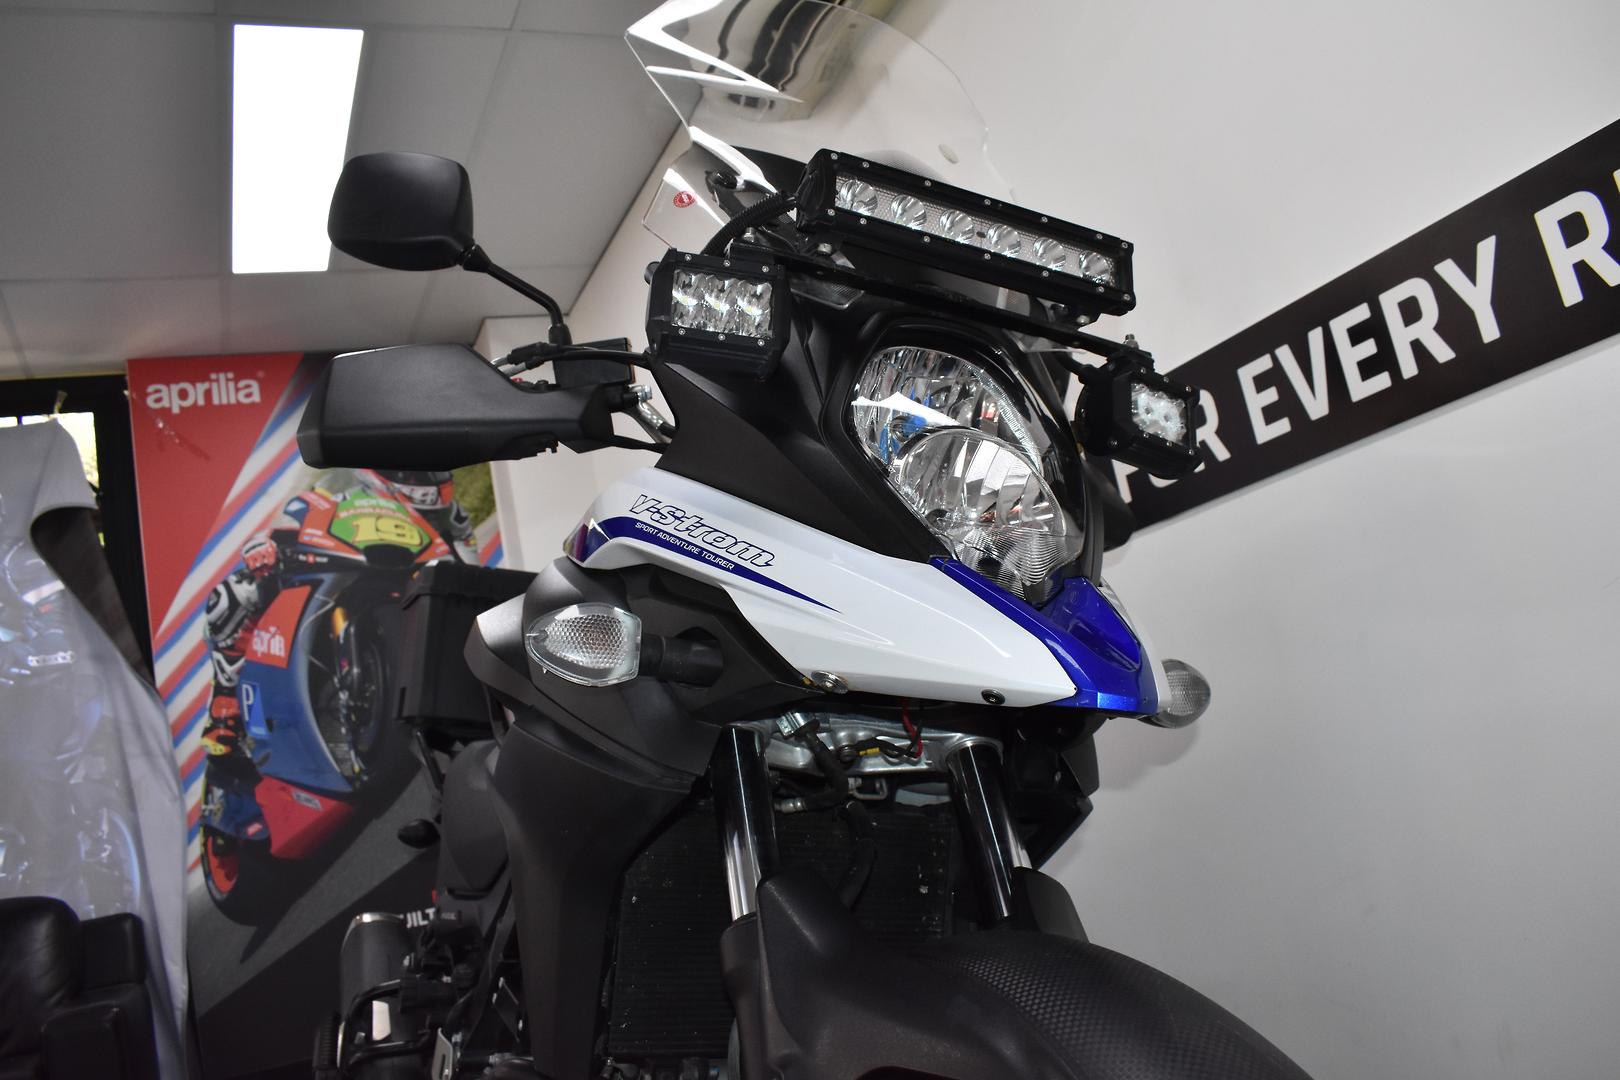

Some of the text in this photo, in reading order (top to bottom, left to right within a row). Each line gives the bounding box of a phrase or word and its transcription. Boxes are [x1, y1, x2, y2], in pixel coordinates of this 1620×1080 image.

[1236, 235, 1501, 445] EVERY
[1534, 168, 1620, 308] R
[146, 372, 261, 414] aprilia
[352, 515, 423, 547] 19
[634, 521, 736, 571] SPORT ADVENTURE TOURER
